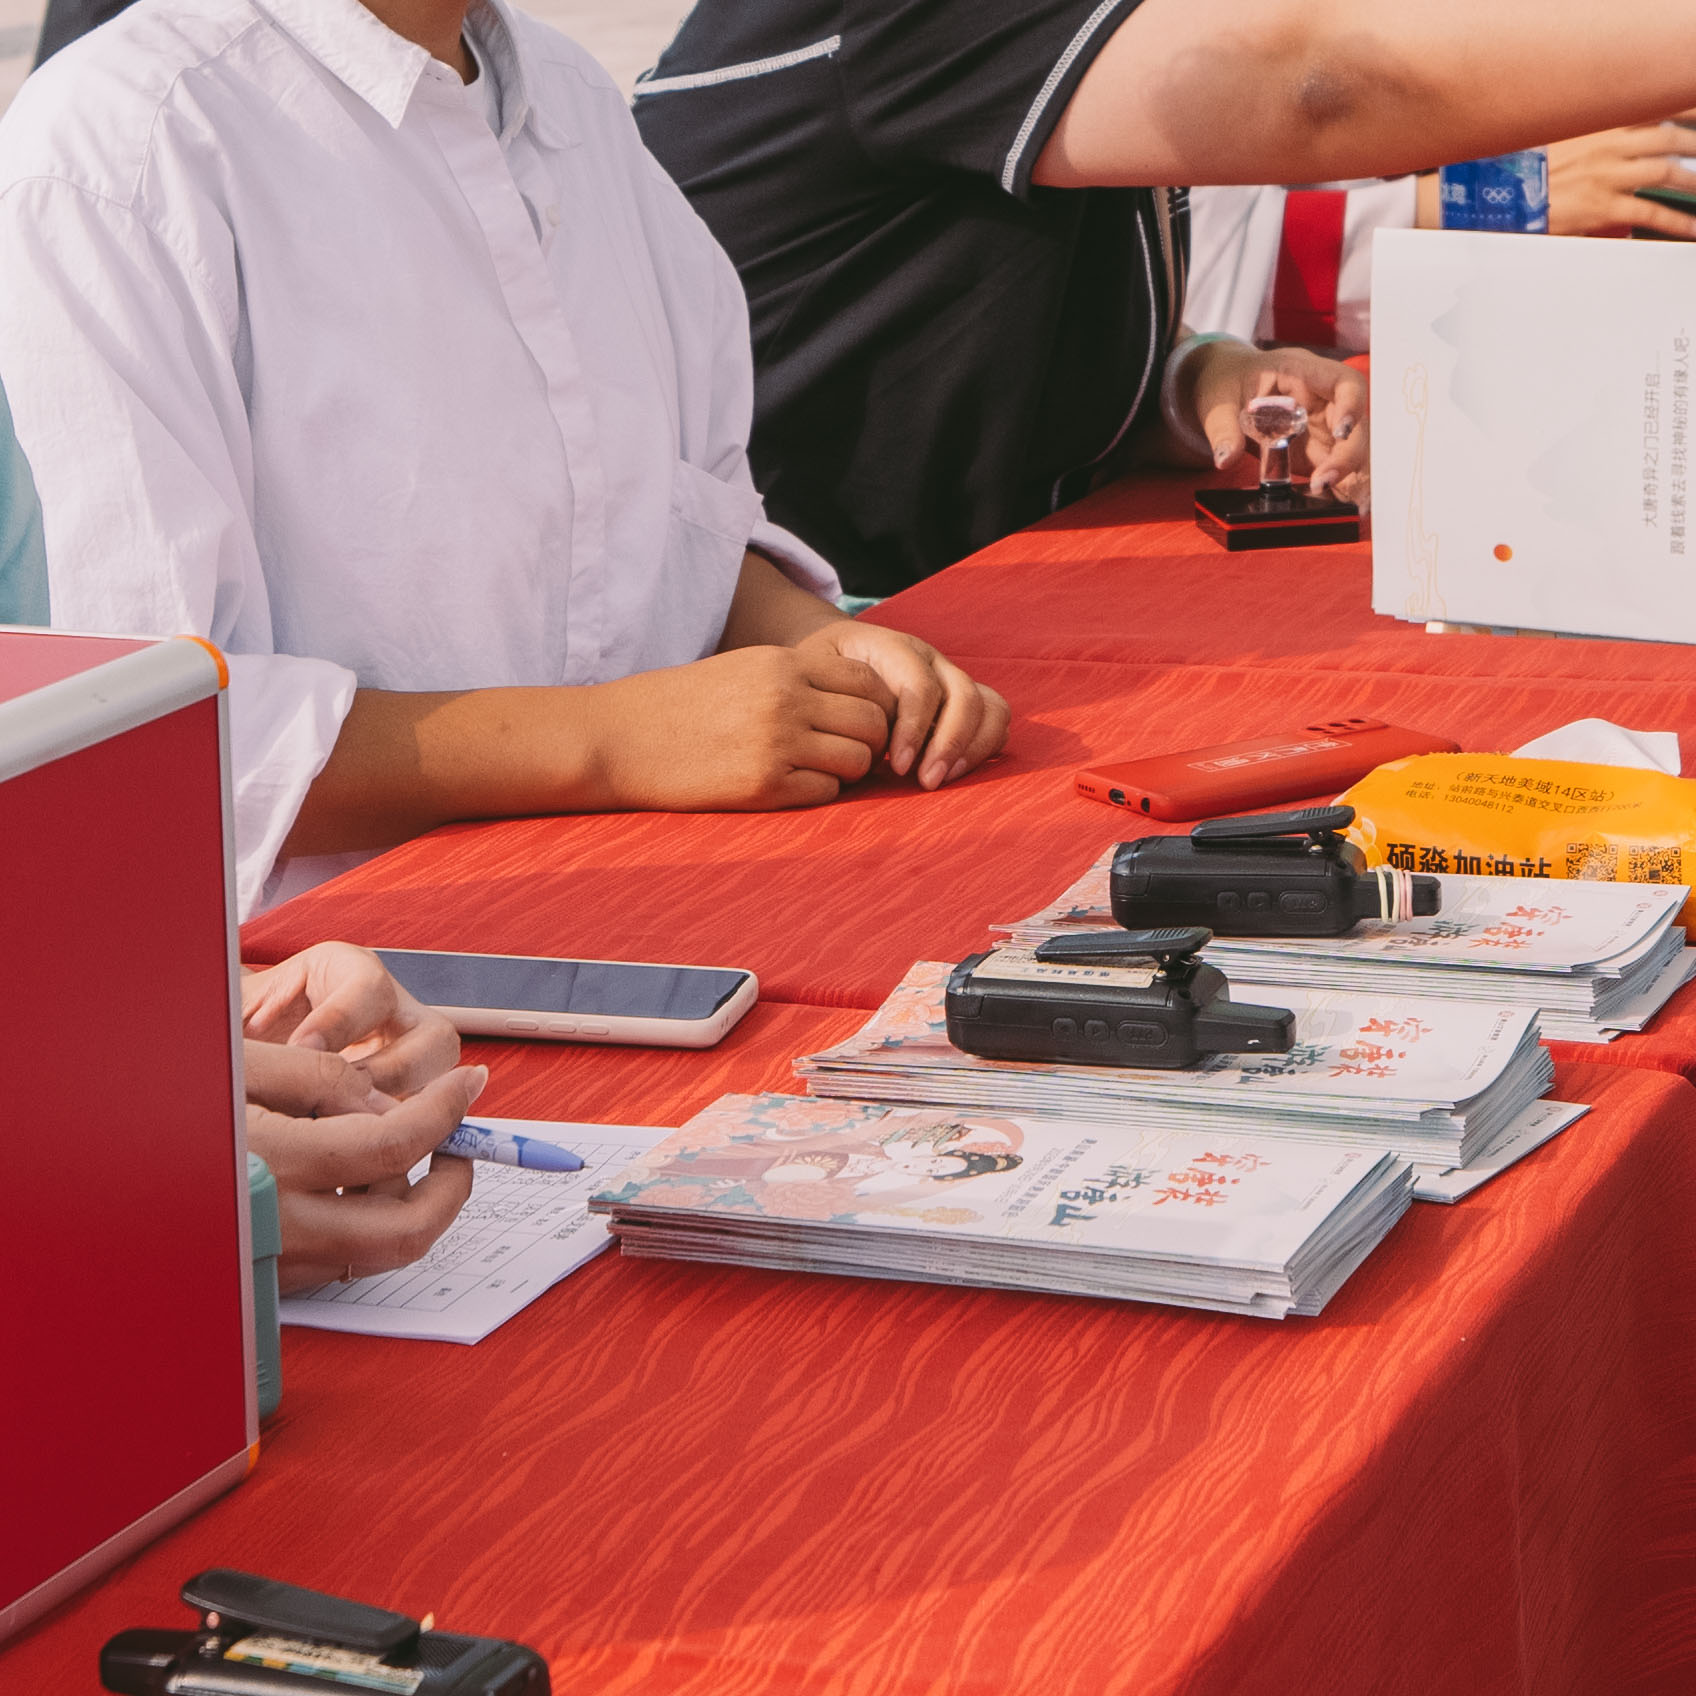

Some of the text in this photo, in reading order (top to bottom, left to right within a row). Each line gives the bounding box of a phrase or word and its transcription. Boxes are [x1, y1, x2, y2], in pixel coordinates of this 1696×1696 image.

[1047, 1164, 1162, 1227] 游唐山
[1152, 1151, 1272, 1207] 穿唐装
